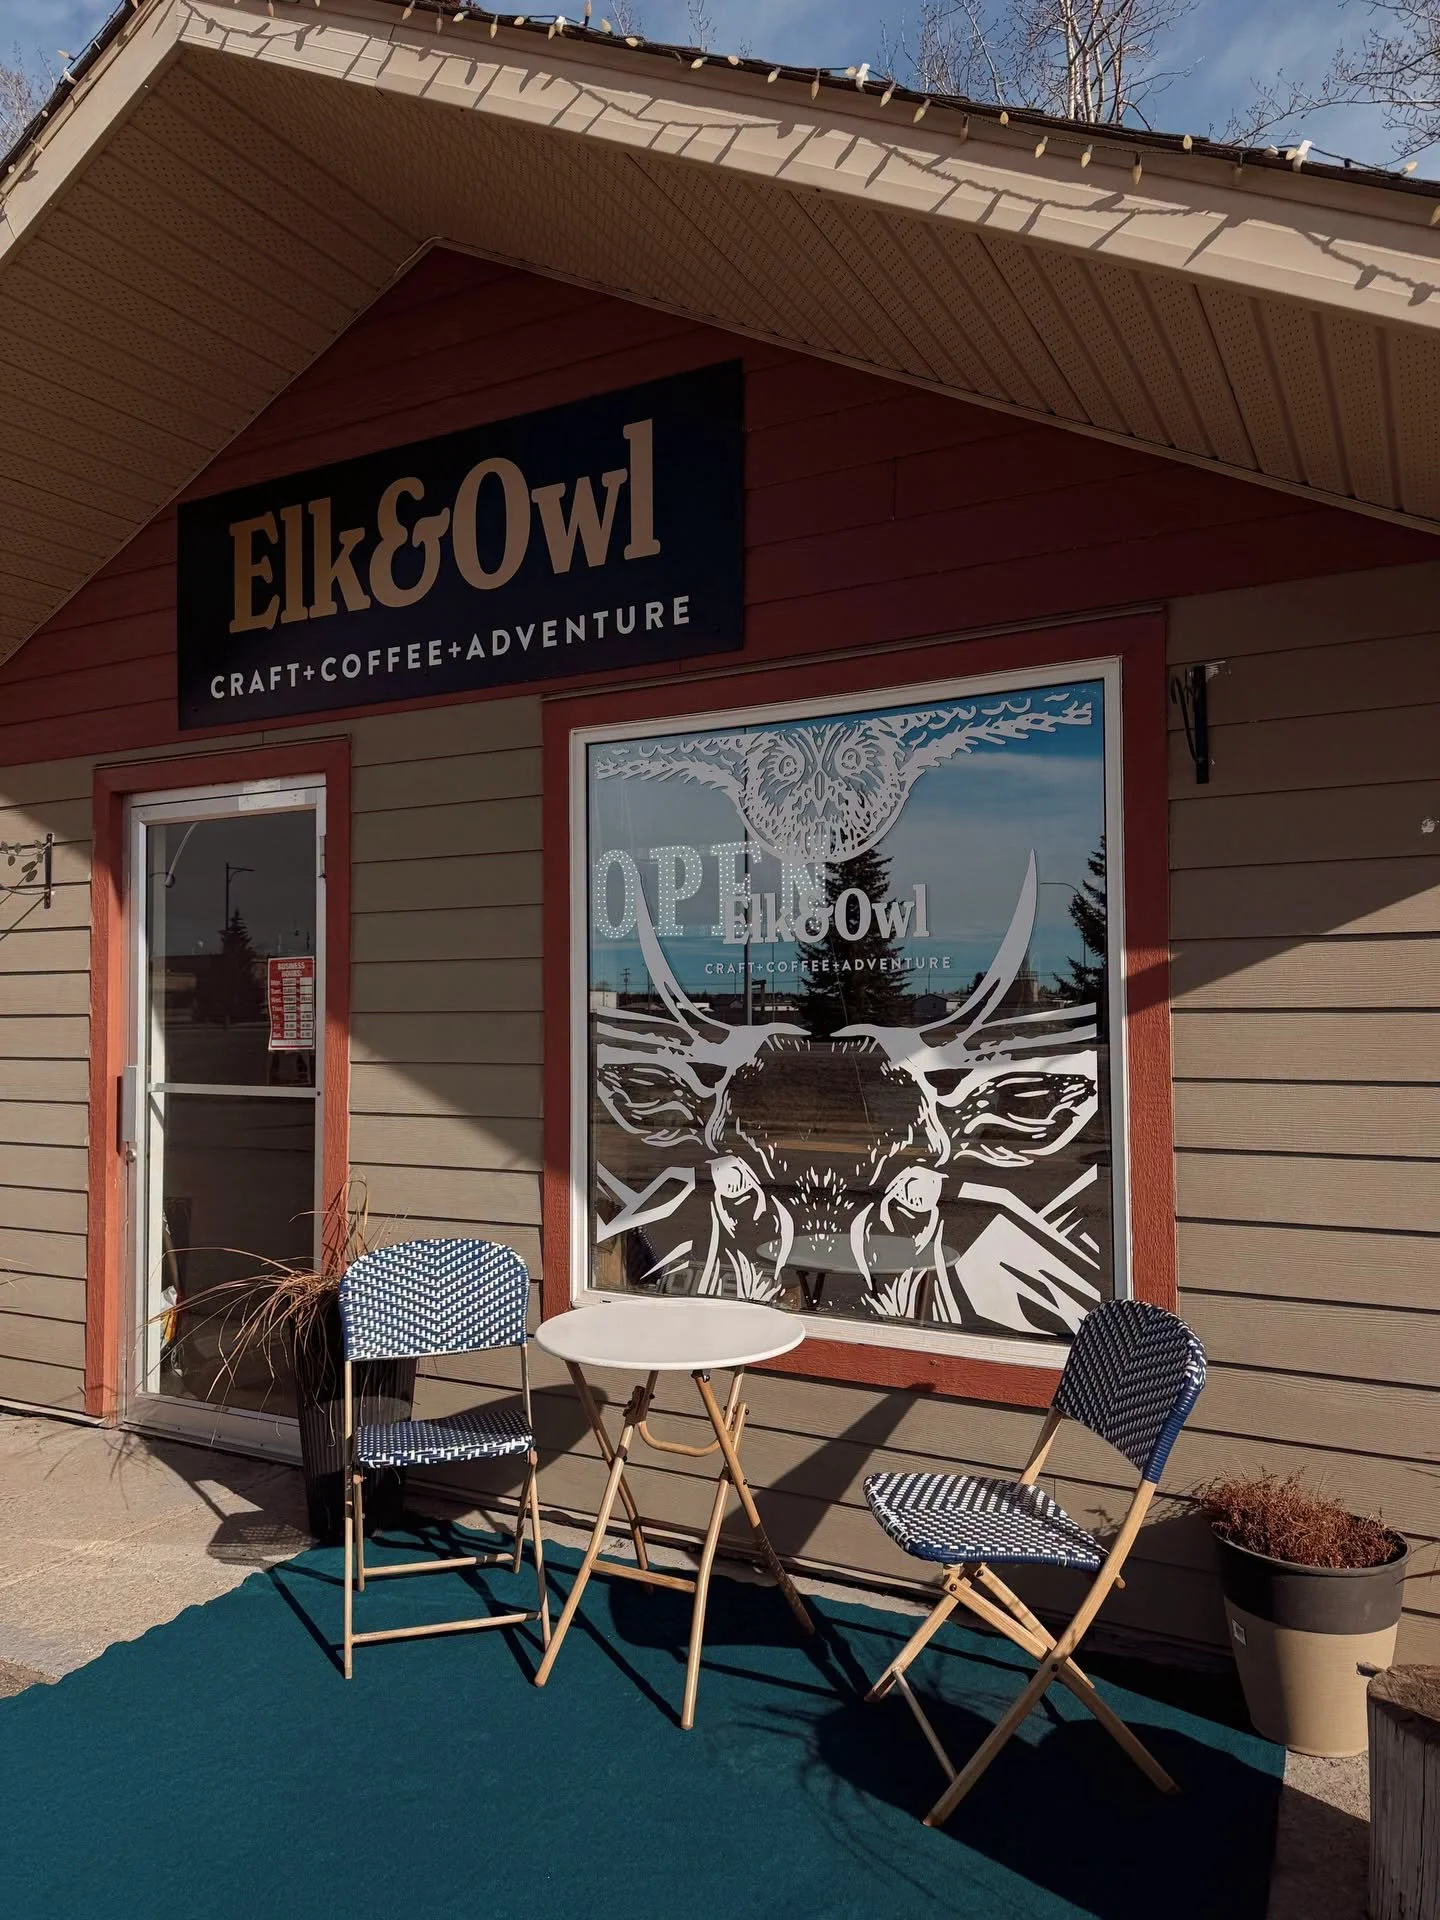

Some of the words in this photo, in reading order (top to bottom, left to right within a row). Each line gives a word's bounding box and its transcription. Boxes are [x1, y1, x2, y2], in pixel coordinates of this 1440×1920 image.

[229, 418, 661, 633] Elk&Owl
[210, 595, 691, 699] CRAFT+COFFEE+ADVENTURE
[592, 834, 827, 939] OPEN
[722, 883, 930, 945] Elk&Owl
[277, 962, 305, 971] BUSINESS
[704, 956, 952, 975] CRAFT+COFFEE+ADVENTURE
